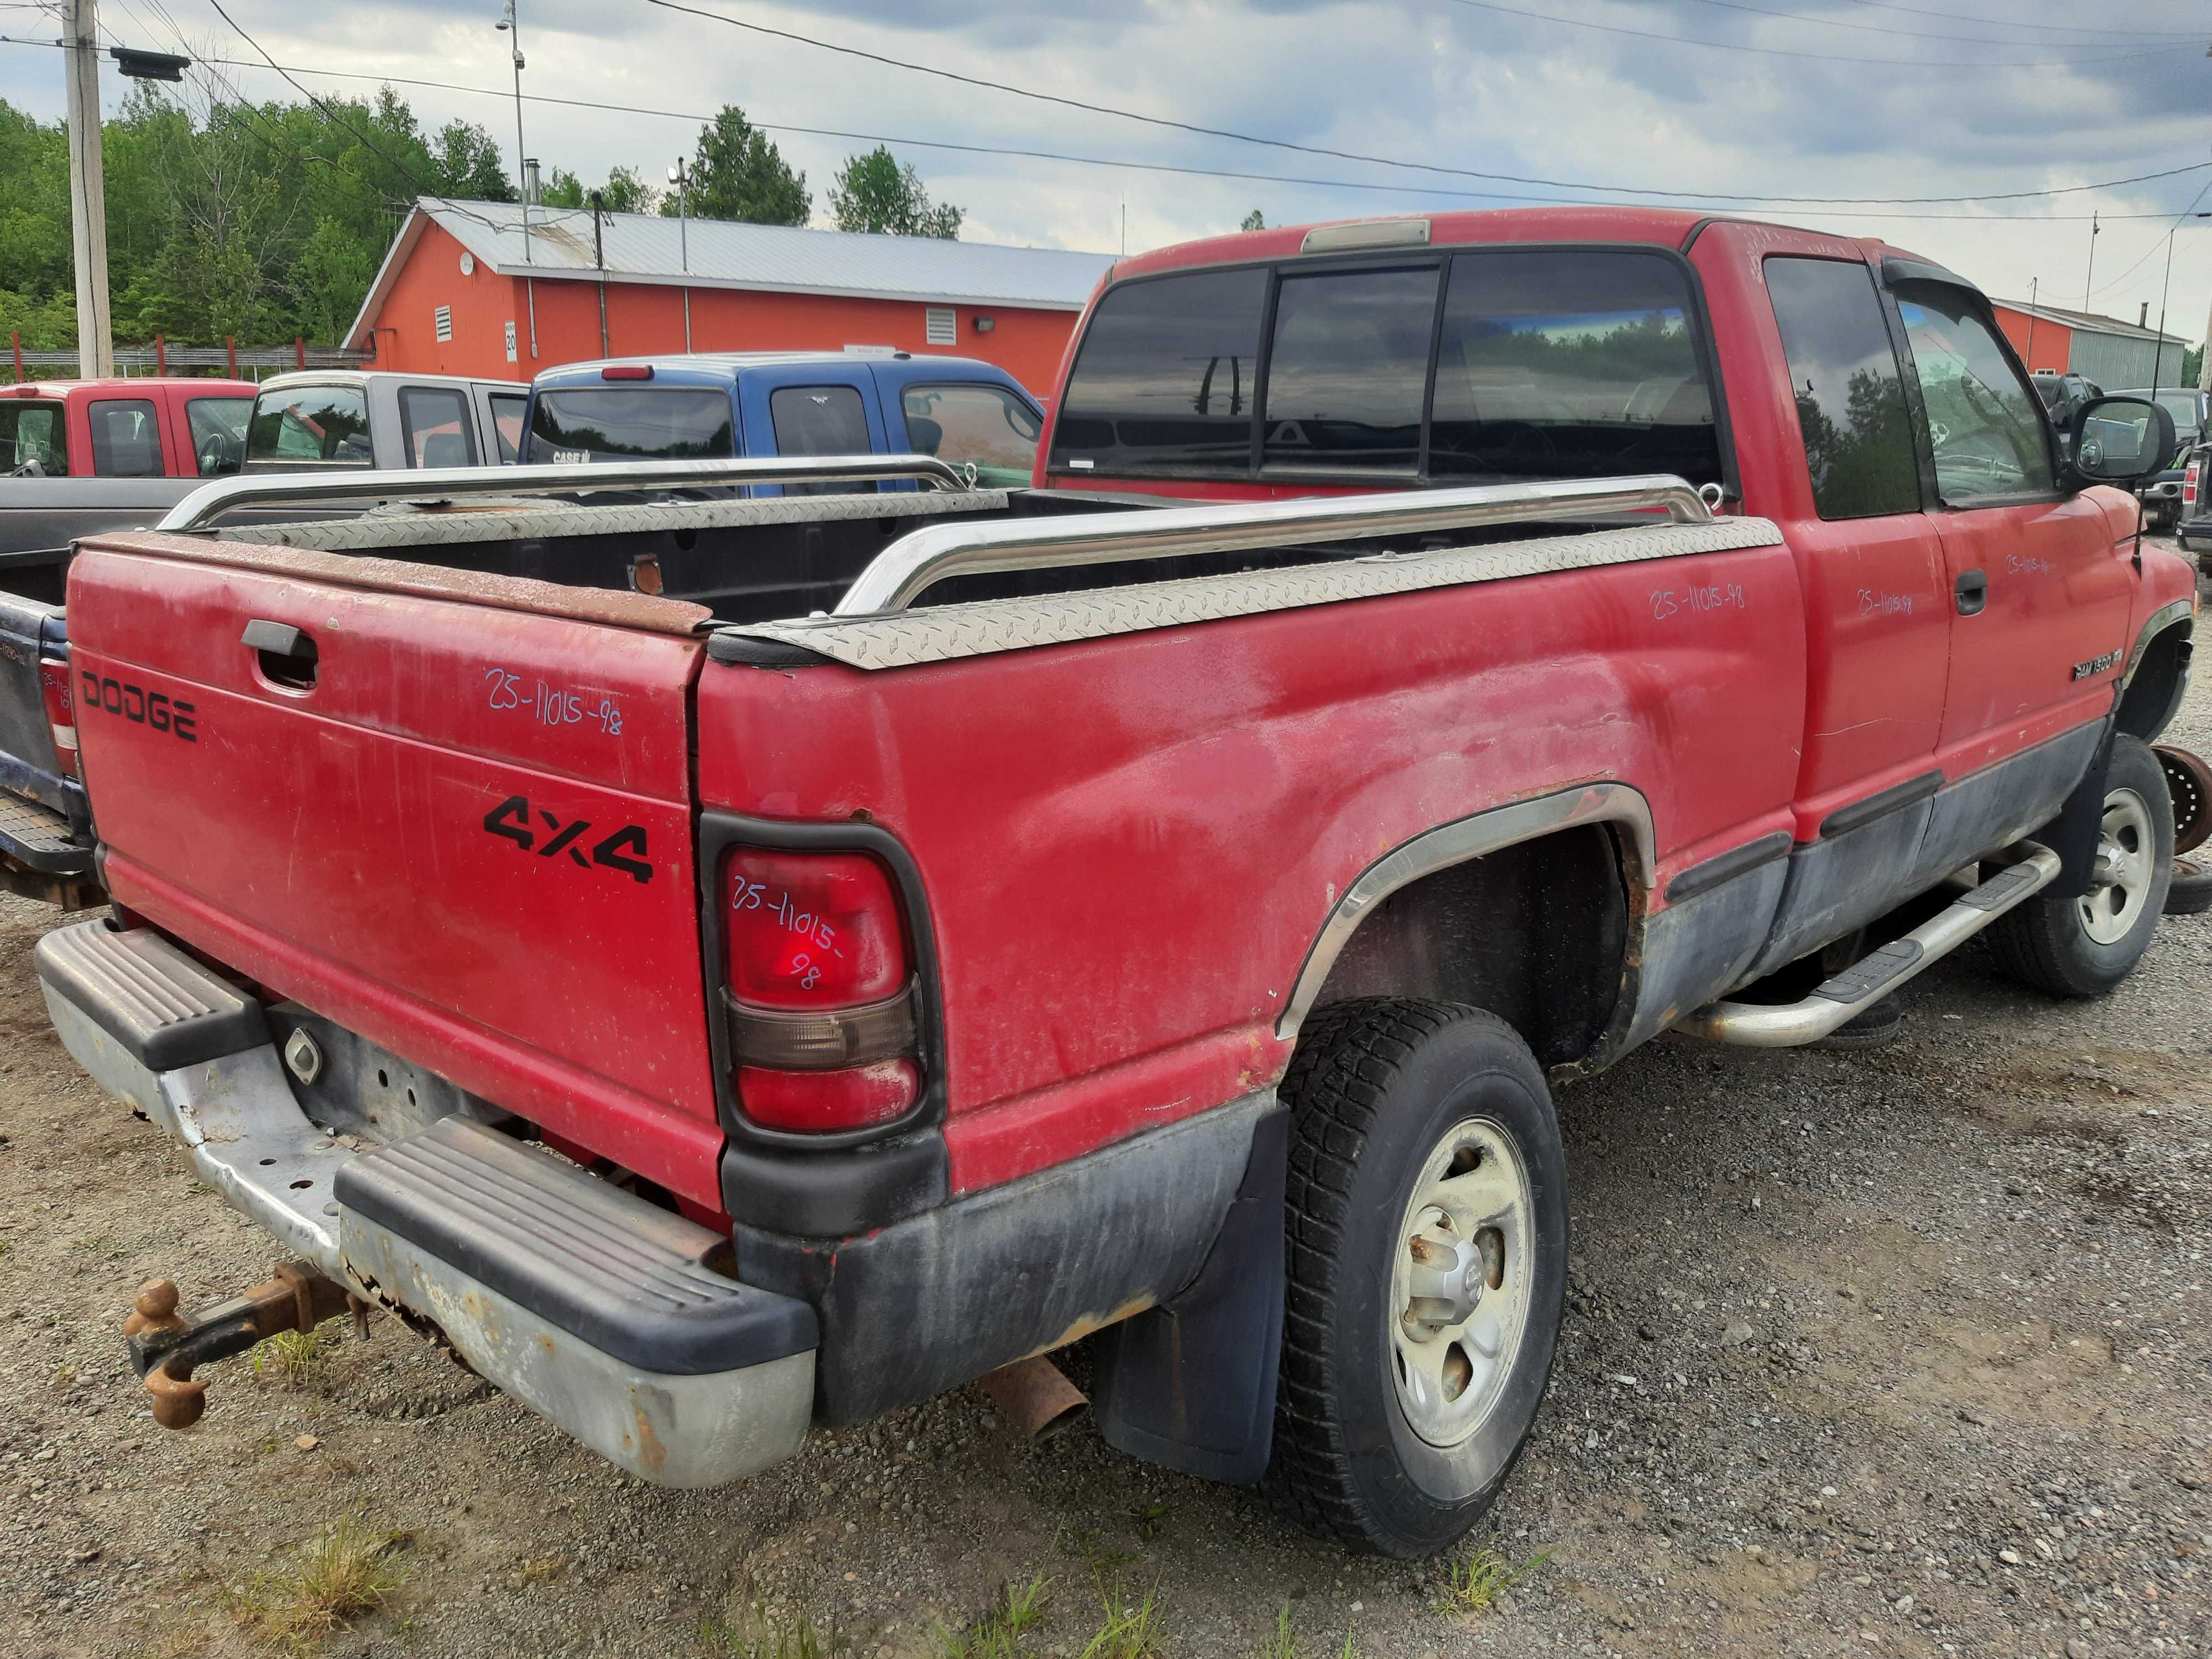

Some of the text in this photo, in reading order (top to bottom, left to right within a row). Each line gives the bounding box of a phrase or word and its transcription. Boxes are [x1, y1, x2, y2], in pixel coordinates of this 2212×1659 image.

[507, 335, 515, 350] 20
[553, 451, 580, 463] CASE
[1650, 584, 1745, 620] 25-11015-98
[2094, 655, 2112, 673] 1500
[82, 670, 197, 743] DODGE
[486, 667, 624, 735] 25-11015-98
[790, 953, 821, 990] 98
